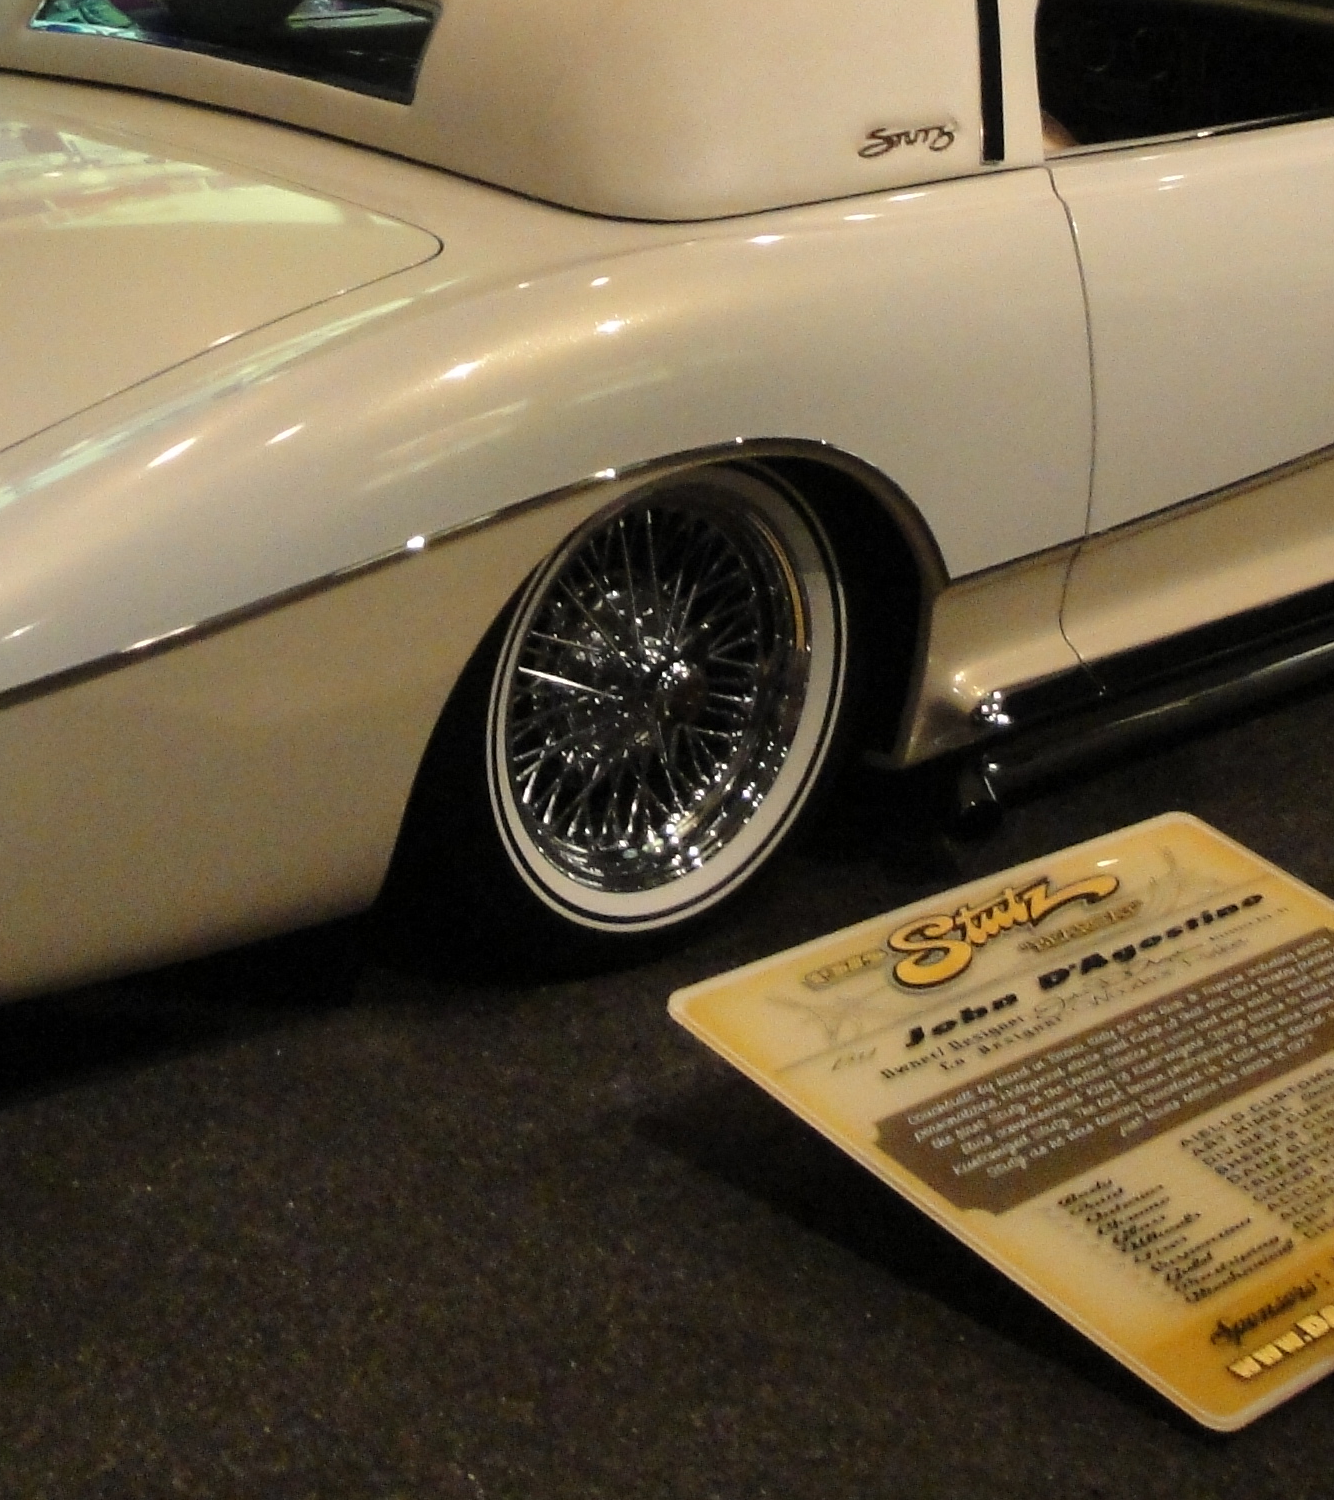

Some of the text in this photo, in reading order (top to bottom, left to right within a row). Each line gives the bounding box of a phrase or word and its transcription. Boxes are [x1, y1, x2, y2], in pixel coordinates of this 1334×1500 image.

[887, 873, 1119, 993] Stutz
[906, 993, 1017, 1047] John
[1038, 894, 1263, 990] D'Agostino
